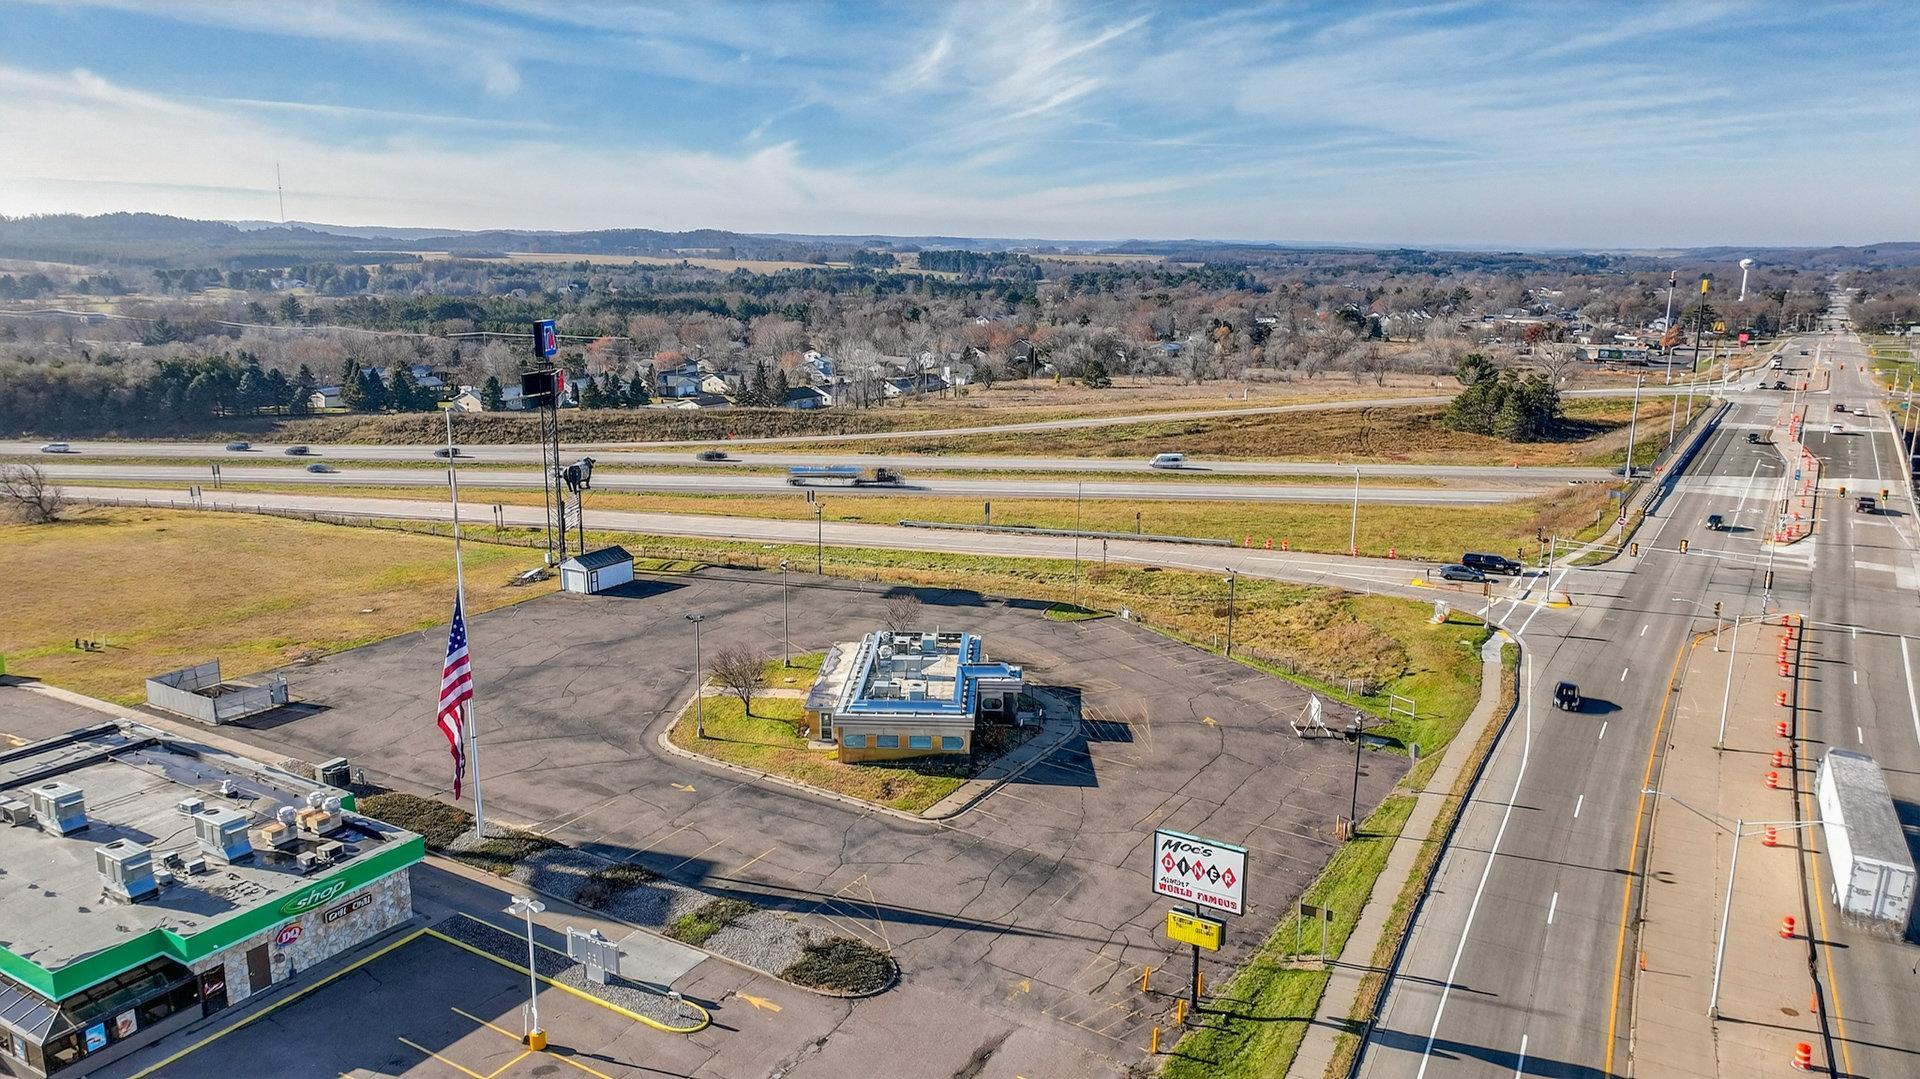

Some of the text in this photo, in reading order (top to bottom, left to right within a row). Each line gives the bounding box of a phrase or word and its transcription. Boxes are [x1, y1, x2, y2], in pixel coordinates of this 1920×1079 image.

[1164, 857, 1233, 885] DINER
[1159, 883, 1237, 910] WORLD FAMOUS
